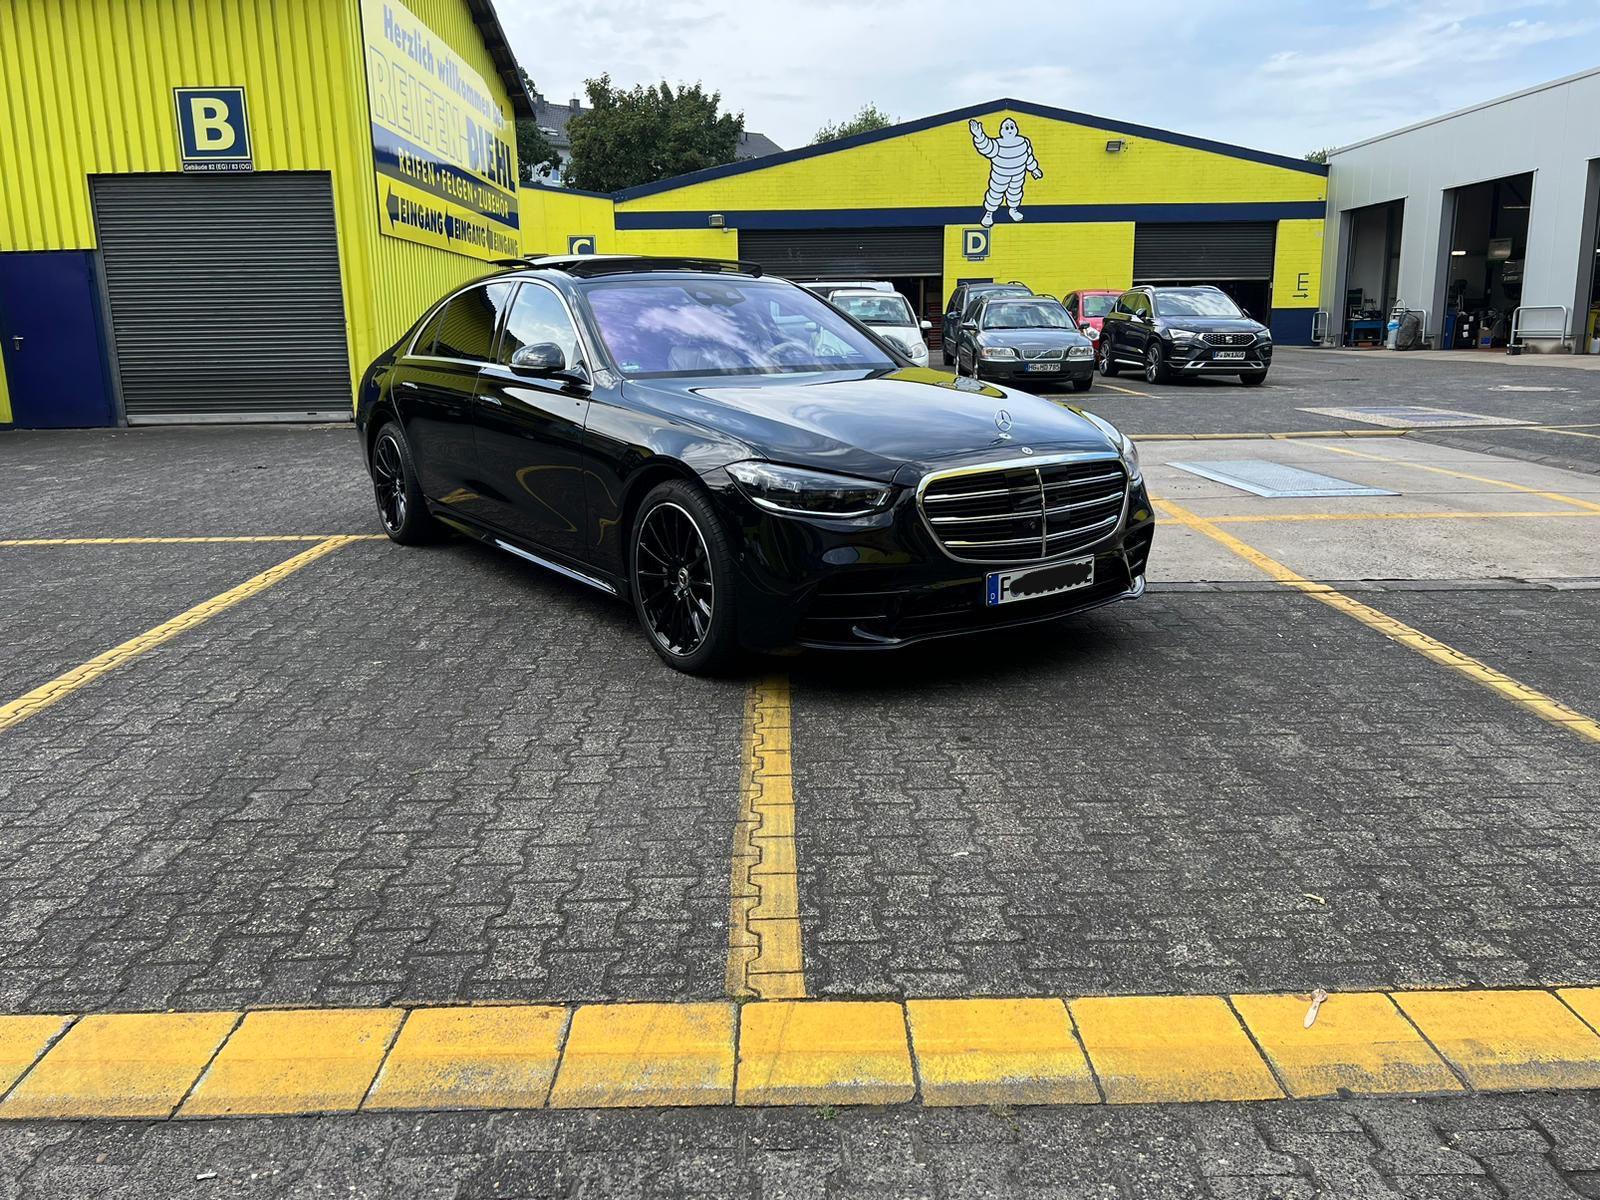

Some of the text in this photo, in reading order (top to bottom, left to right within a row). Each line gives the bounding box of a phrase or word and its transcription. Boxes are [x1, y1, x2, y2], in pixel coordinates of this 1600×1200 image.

[383, 4, 434, 75] Herzlich
[437, 55, 491, 119] willkommen
[190, 97, 235, 151] B
[184, 163, 207, 171] Gebäude
[398, 147, 509, 219] REIFEN FELGEN ZUBEHÖR
[400, 196, 519, 258] EINGANG EINGANG EINGANG
[967, 231, 987, 254] D
[572, 239, 591, 255] C
[1297, 272, 1309, 291] E
